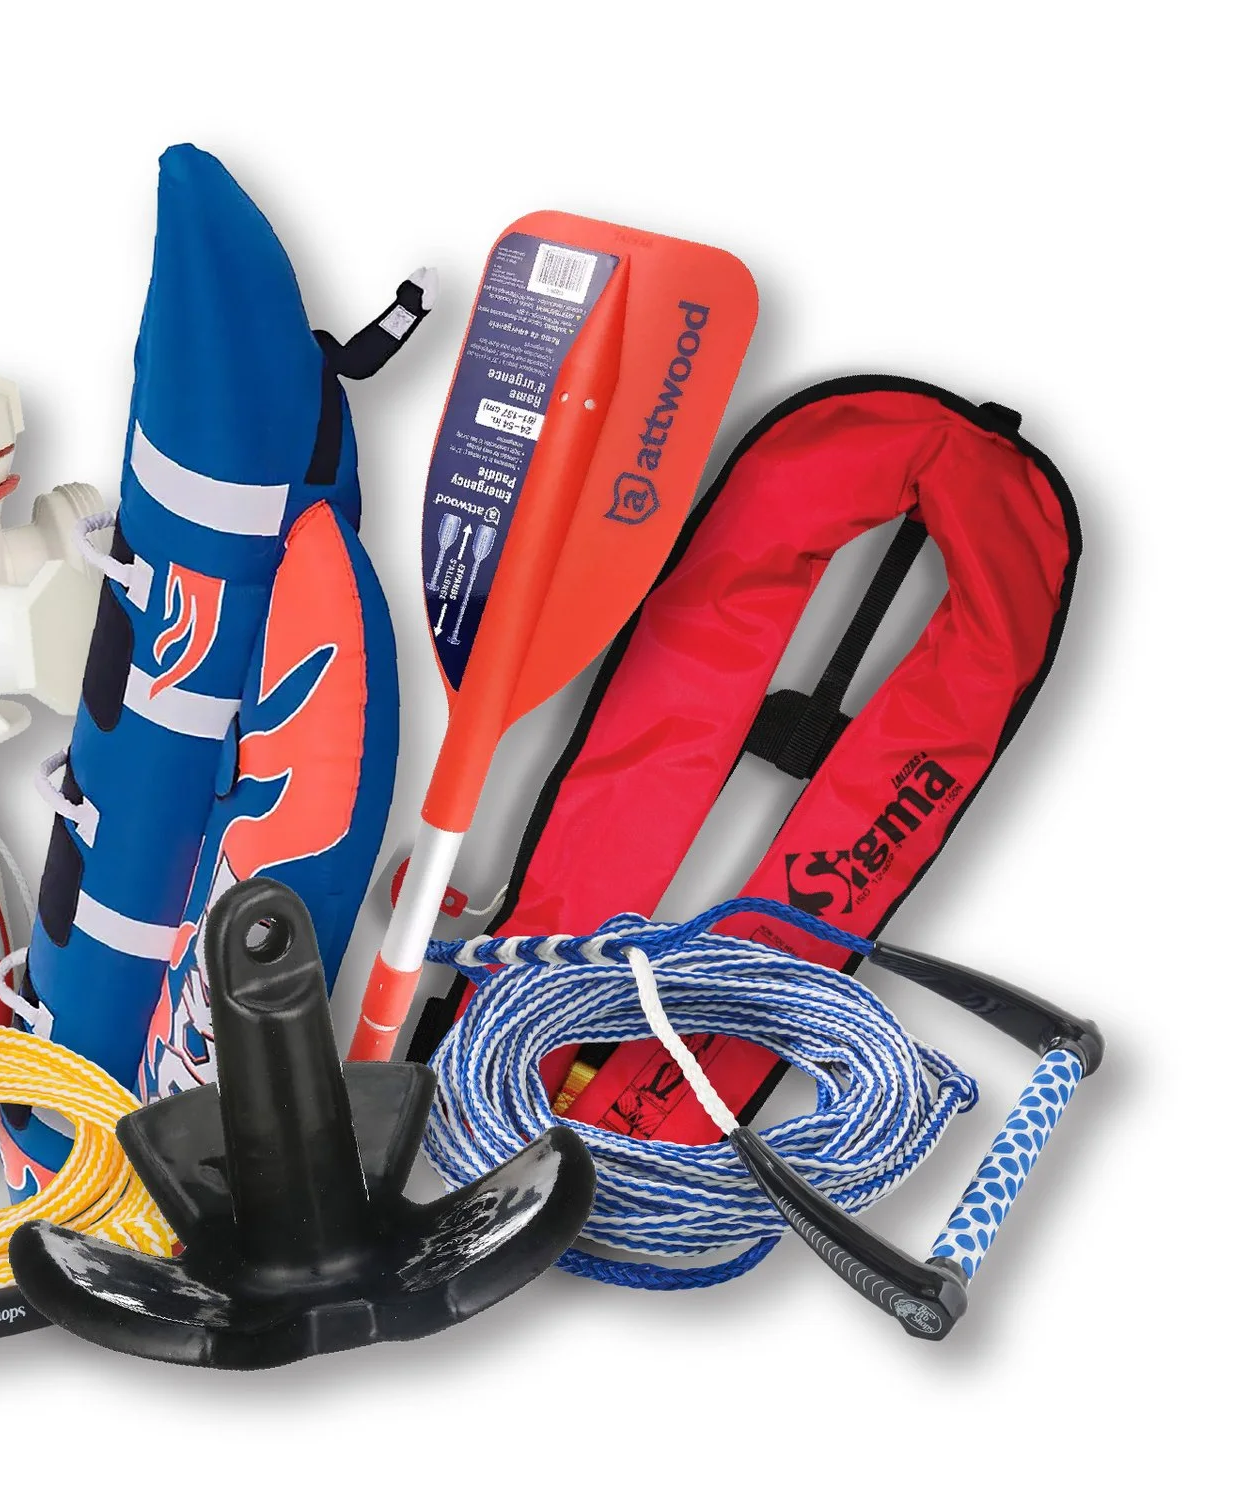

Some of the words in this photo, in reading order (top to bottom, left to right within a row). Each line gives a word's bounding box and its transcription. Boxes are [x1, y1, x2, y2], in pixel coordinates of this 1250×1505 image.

[487, 368, 546, 393] d'urgence
[637, 300, 710, 472] attwood
[509, 389, 542, 408] Rame
[451, 473, 513, 504] Emergency
[477, 466, 517, 489] Paddle
[435, 493, 485, 516] attwood
[450, 563, 466, 601] EXPANDS
[786, 760, 956, 917] Sigma
